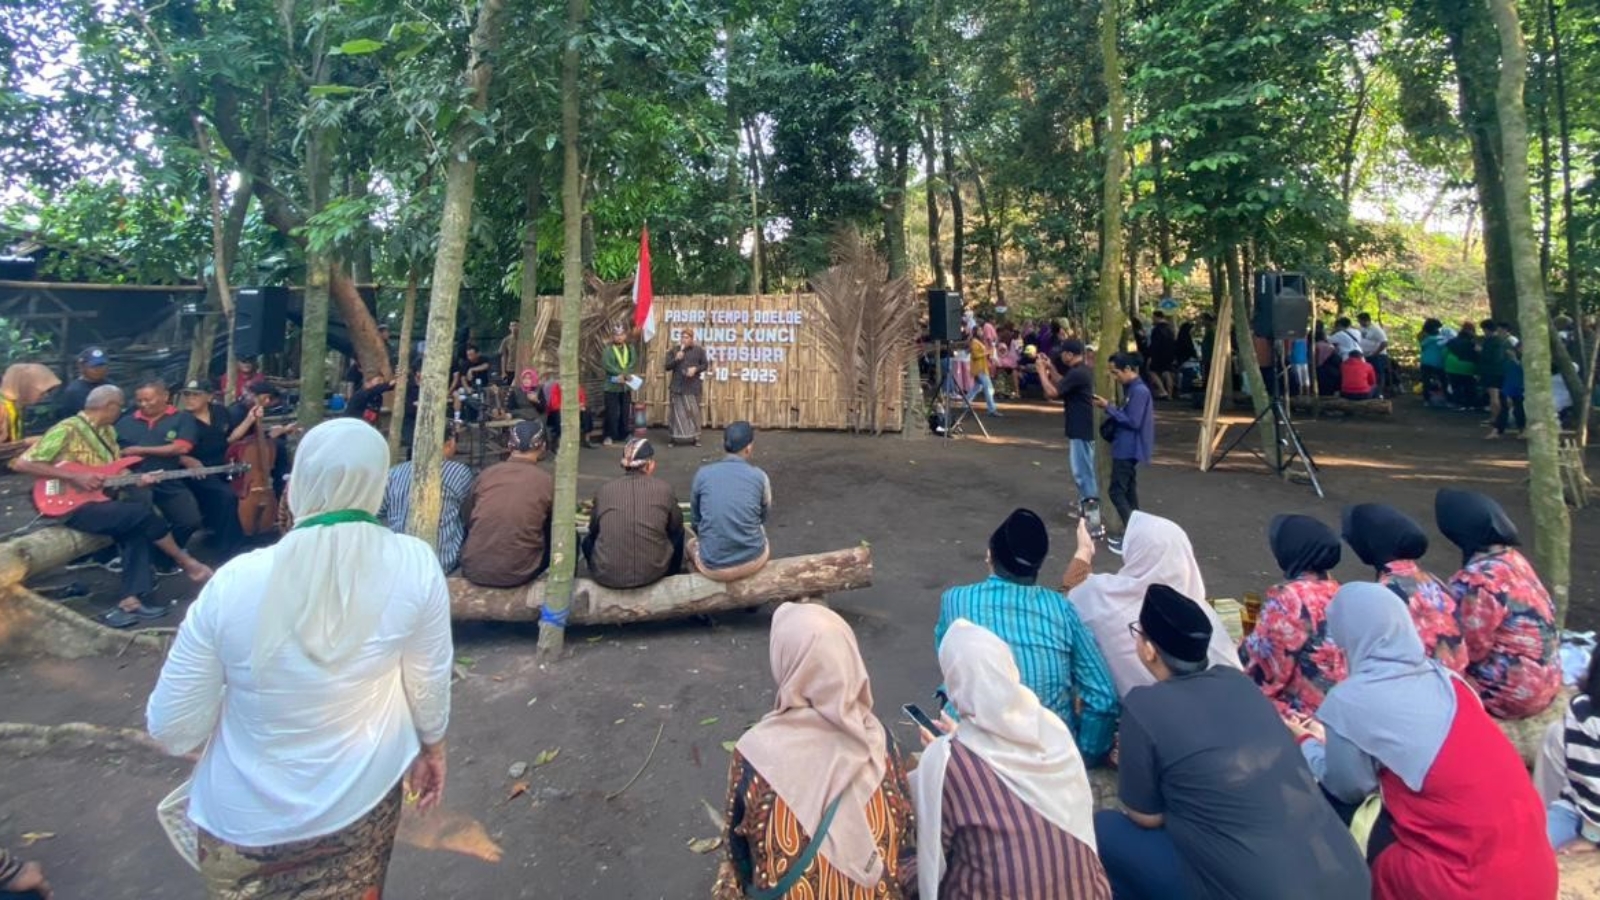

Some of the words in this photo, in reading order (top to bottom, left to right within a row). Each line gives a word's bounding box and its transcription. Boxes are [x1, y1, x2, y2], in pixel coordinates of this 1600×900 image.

[665, 310, 705, 323] PASAR
[712, 310, 748, 323] TEMPO
[671, 328, 736, 343] GNUNG
[744, 328, 795, 343] KUNCI
[706, 347, 784, 362] RTASURA
